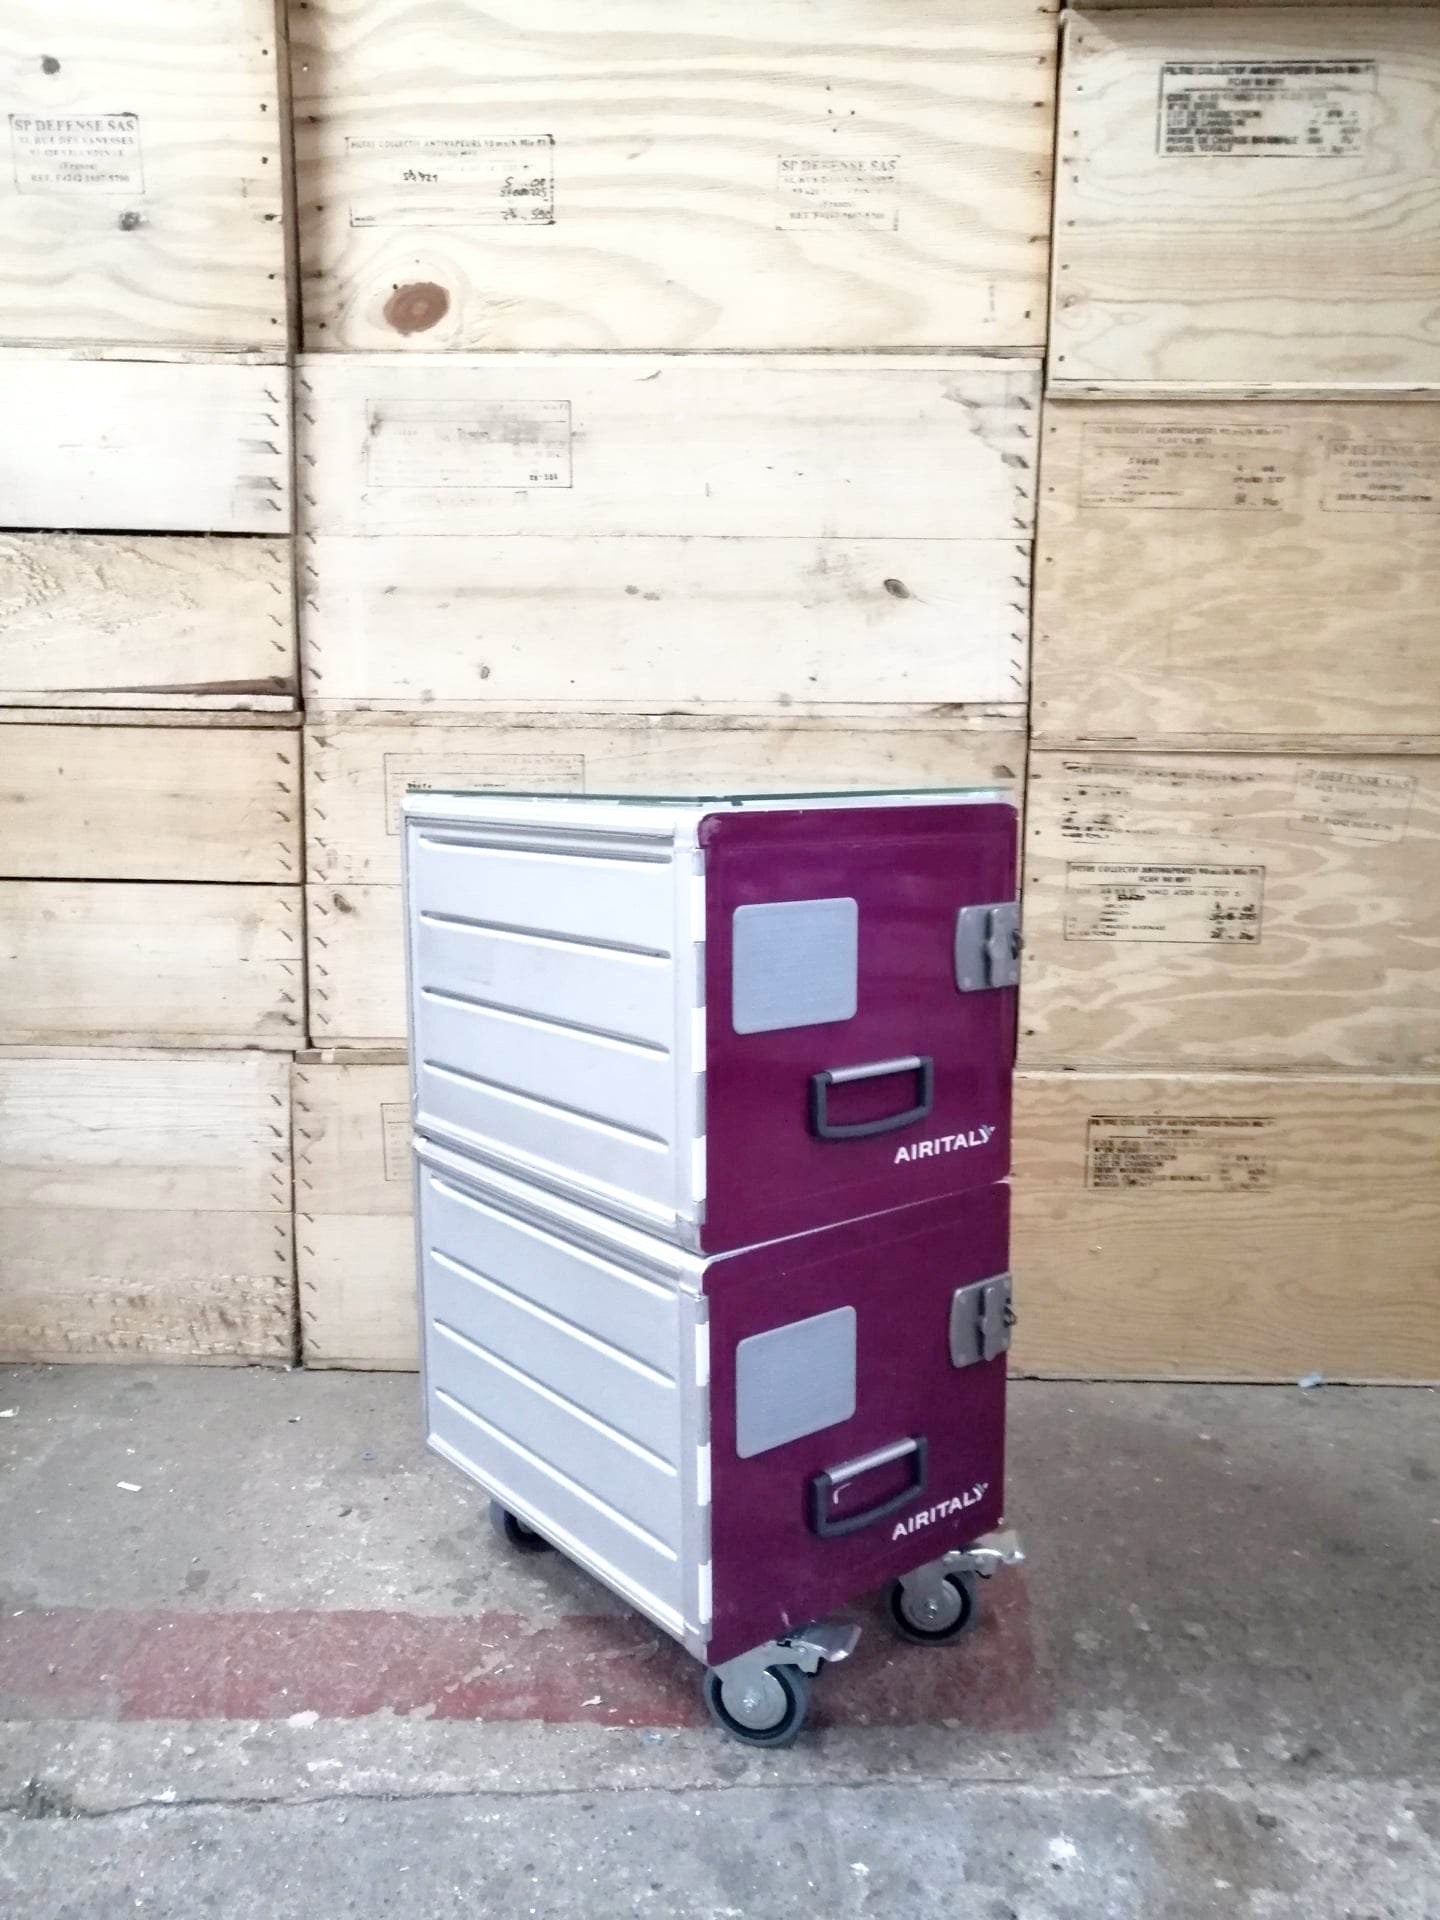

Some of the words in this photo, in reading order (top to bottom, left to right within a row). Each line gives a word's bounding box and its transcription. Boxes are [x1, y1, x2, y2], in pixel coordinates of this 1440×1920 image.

[14, 119, 32, 131] SP
[34, 119, 102, 132] DEFENSE
[107, 119, 135, 131] SAS
[894, 1124, 996, 1164] AIRITALY
[892, 1482, 989, 1541] AIRITALY
